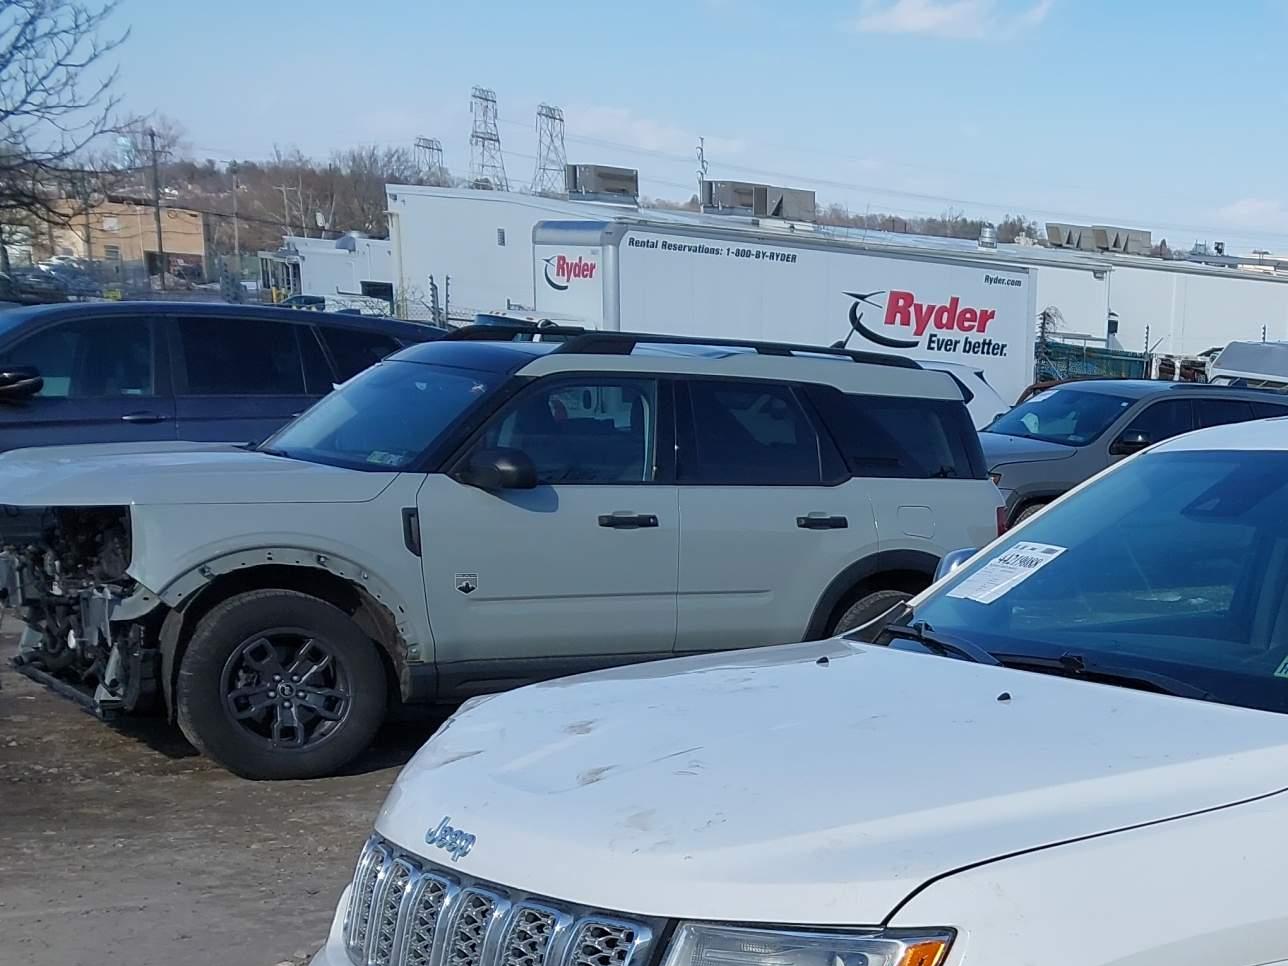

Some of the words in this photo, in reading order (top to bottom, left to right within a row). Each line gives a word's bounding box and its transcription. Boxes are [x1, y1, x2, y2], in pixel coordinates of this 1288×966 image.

[628, 237, 658, 249] Rental
[661, 240, 723, 256] Reservations:
[726, 247, 797, 263] 1-800-BY-RYDER
[556, 255, 596, 283] Ryder
[984, 274, 1022, 287] Ryder.com
[884, 290, 996, 337] Ryder
[927, 333, 961, 352] Ever
[962, 336, 1008, 357] better.
[425, 815, 477, 862] Jeep
